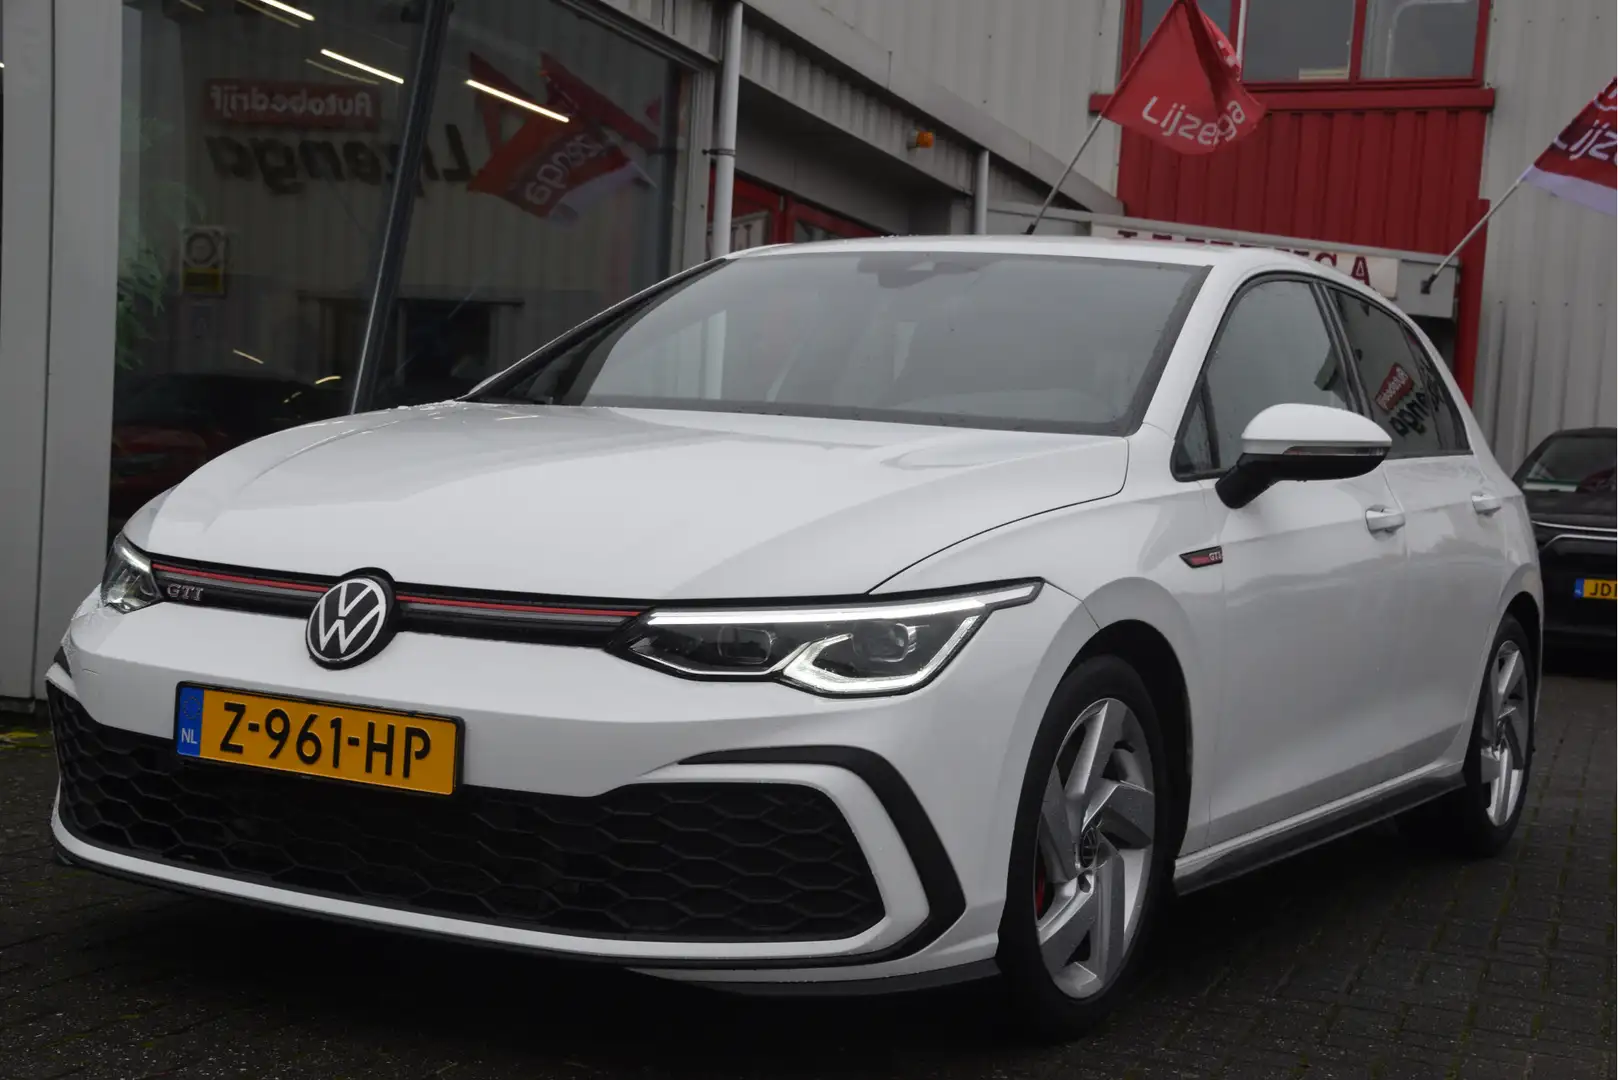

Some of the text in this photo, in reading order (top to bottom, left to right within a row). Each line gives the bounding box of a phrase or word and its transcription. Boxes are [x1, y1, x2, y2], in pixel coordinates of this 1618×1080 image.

[1553, 119, 1617, 165] Lijz
[166, 583, 204, 600] GTI
[1589, 582, 1617, 597] JD
[180, 727, 198, 745] NL
[219, 701, 431, 778] Z-961-HP
